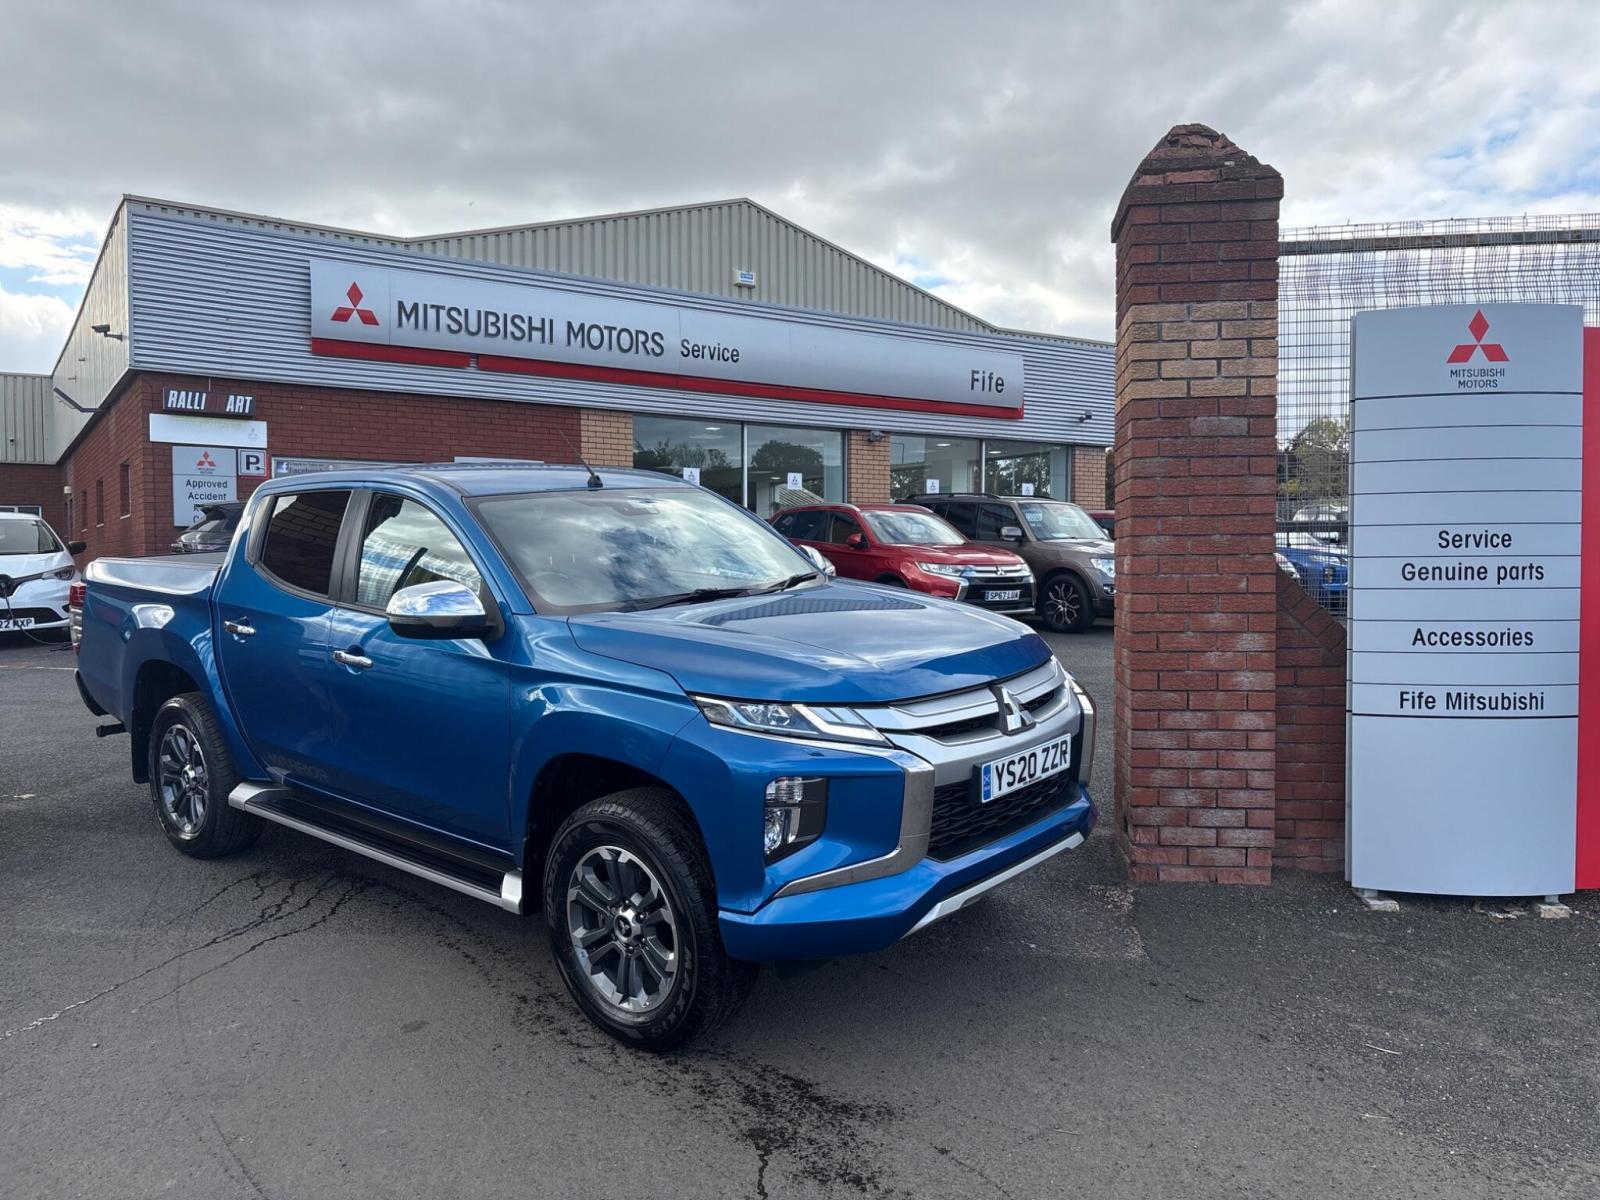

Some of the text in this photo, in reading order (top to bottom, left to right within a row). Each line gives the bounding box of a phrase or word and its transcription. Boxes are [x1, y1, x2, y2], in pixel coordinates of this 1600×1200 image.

[397, 300, 740, 363] MITSUBISHI MOTORS Service
[970, 370, 1005, 393] Fife
[1450, 368, 1505, 378] MITSUBISHI
[1458, 379, 1498, 389] MOTORS
[167, 390, 253, 413] RALLI ART
[185, 479, 228, 490] Approved
[187, 491, 227, 501] Accident
[1438, 529, 1512, 549] Service
[1401, 562, 1545, 585] Genuine parts
[1411, 627, 1534, 647] Accessories
[1399, 691, 1545, 711] Fife Mitsubishi
[995, 740, 1069, 791] YS20 ZZR
